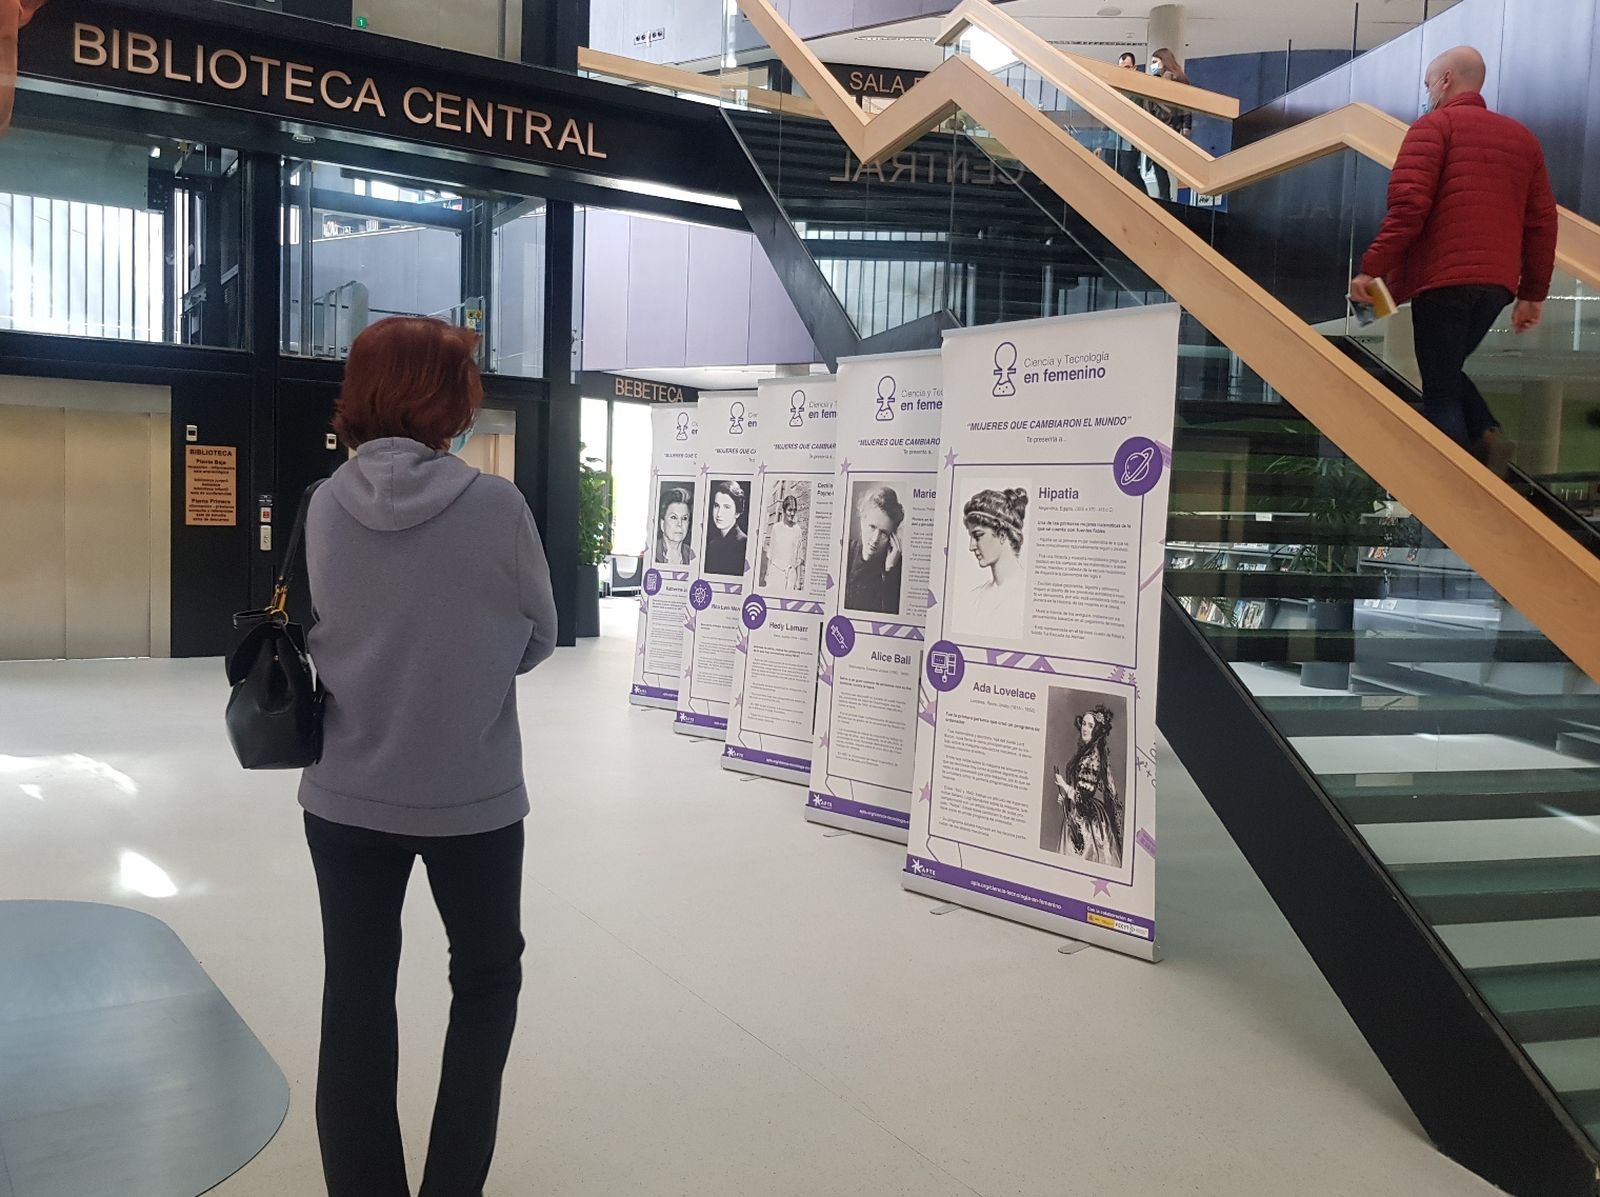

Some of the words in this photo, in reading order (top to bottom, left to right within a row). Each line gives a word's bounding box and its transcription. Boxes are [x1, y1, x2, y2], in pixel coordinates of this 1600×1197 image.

[849, 71, 905, 93] SALA
[74, 22, 387, 118] BIBLIOTECA
[402, 86, 608, 159] CENTRAL
[1024, 357, 1055, 368] Ciencia
[1057, 358, 1062, 367] y
[1024, 372, 1039, 384] en
[1043, 365, 1106, 382] femenino
[615, 377, 684, 403] BEBETECA
[900, 401, 913, 411] en
[917, 398, 943, 411] feme
[808, 410, 819, 419] en
[821, 408, 837, 419] fem
[747, 420, 758, 428] en
[1009, 420, 1029, 430] QUE
[1029, 418, 1082, 429] CAMBIARON
[1083, 418, 1093, 428] EL
[889, 438, 904, 446] QUE
[189, 448, 233, 457] BIBLIOTECA
[913, 488, 937, 499] Marie
[1038, 487, 1079, 501] Hipatia
[769, 621, 785, 632] Hedy
[785, 623, 809, 633] Lamarr
[870, 651, 893, 662] Alice
[894, 654, 912, 665] Ball
[972, 682, 991, 694] Ada
[994, 684, 1037, 700] Lovelace
